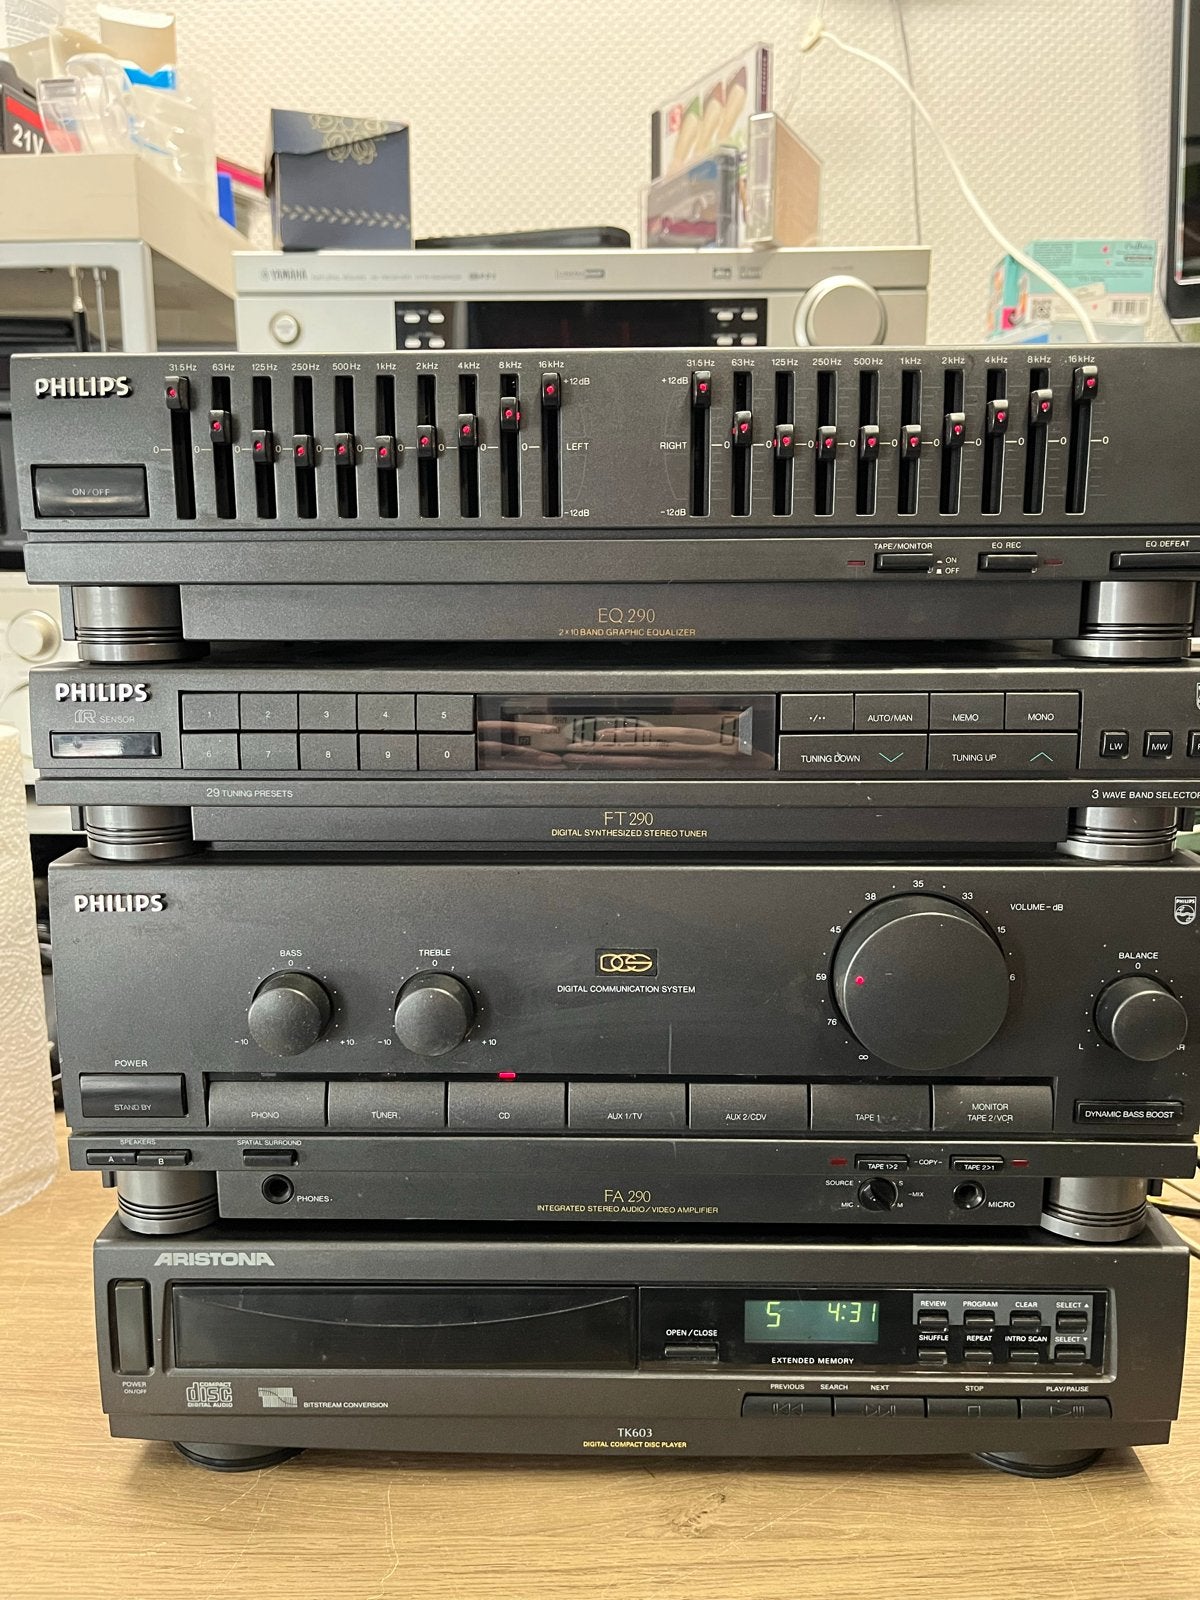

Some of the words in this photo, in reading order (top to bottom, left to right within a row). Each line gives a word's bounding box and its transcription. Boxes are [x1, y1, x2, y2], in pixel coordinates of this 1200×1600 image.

[13, 123, 44, 155] 21V
[35, 376, 129, 397] PHILIPS
[566, 442, 589, 450] LEFT
[660, 442, 687, 450] RIGHT
[874, 542, 932, 550] TAPE/MONITOR
[992, 542, 1004, 550] EQ
[1146, 540, 1158, 548] EQ
[598, 608, 623, 624] EQ
[628, 608, 656, 623] 290
[647, 628, 696, 636] EQUALIZER
[55, 683, 148, 702] PHILIPS
[100, 715, 135, 723] SENSOR
[867, 714, 913, 722] AUTO/MAN
[952, 714, 979, 722] MEMO
[1028, 712, 1054, 721] MONO
[800, 754, 832, 763] TUNING
[834, 754, 860, 763] DOWN
[952, 754, 984, 762] TUNING
[985, 753, 997, 762] UP
[206, 788, 220, 798] 29
[1092, 789, 1099, 799] 3
[604, 812, 626, 826] FT
[629, 812, 654, 826] 290
[552, 828, 582, 836] DIGITAL
[864, 892, 876, 900] 38
[74, 894, 163, 912] PHILIPS
[830, 926, 842, 934] 45
[1118, 952, 1158, 960] BALANCE
[816, 973, 827, 981] 59
[827, 1018, 837, 1026] 76
[856, 1114, 874, 1122] TAPE
[604, 1190, 624, 1202] FA
[628, 1190, 651, 1203] 290
[620, 1206, 676, 1214] AUDIO/VIDEO
[154, 1252, 275, 1266] ARISTONA
[766, 1301, 782, 1328] 5
[828, 1302, 877, 1323] 4:31
[617, 1428, 653, 1438] TK603
